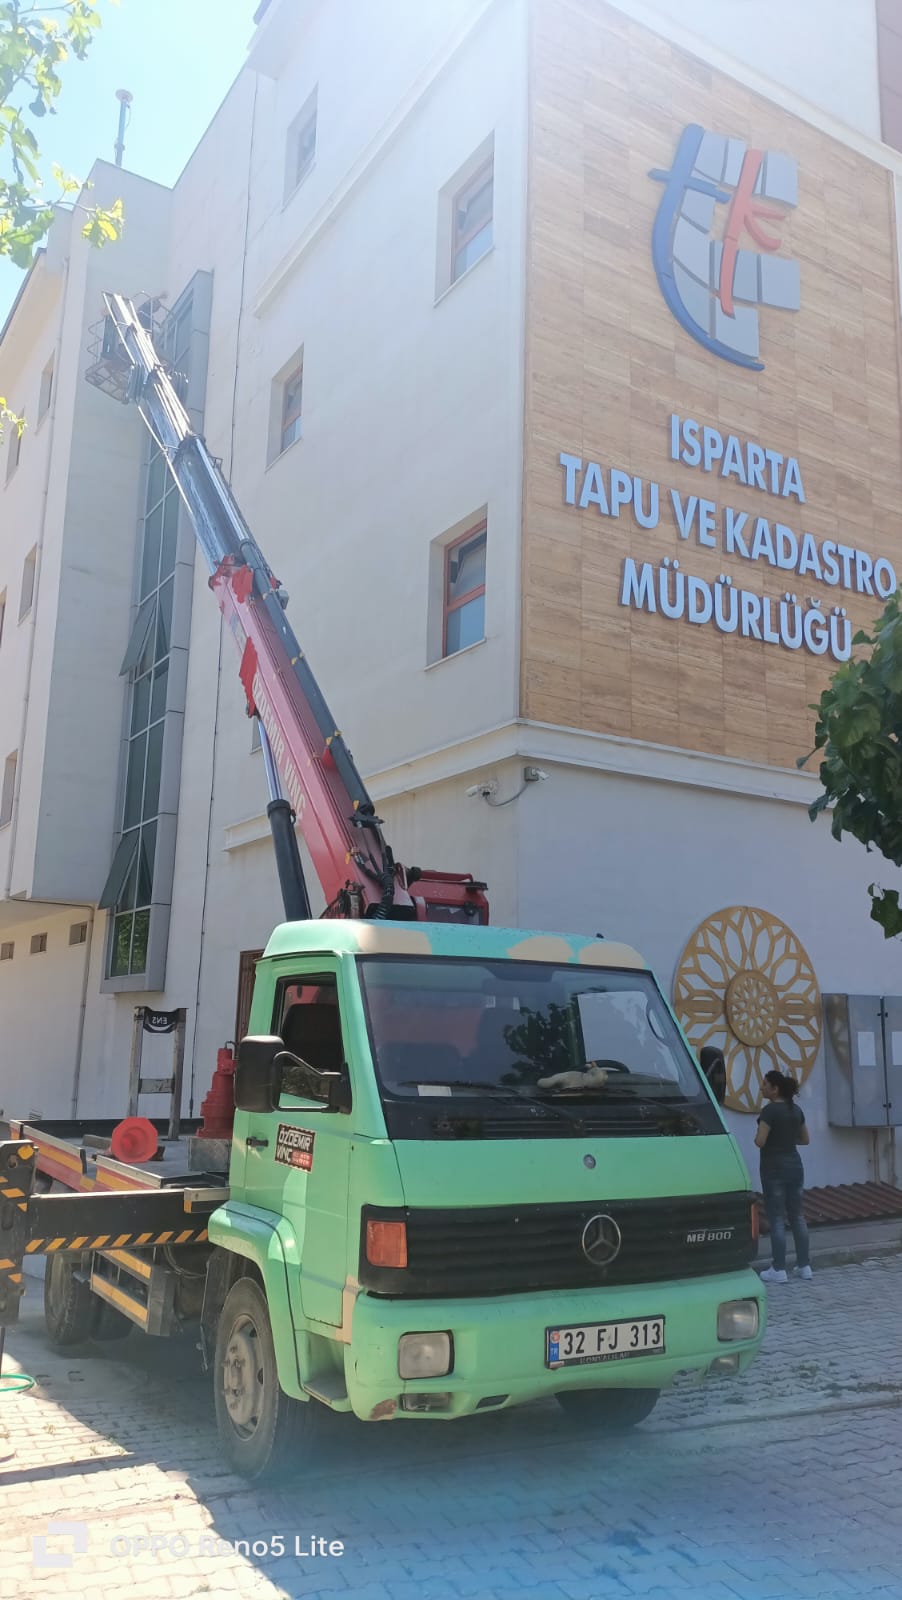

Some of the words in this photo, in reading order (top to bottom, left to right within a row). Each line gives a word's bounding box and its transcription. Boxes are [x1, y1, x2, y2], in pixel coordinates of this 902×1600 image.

[670, 413, 807, 504] ISPARTA
[559, 452, 660, 530] TAPU
[669, 488, 718, 549] VE
[725, 506, 898, 601] KADASTRO
[619, 555, 853, 663] MÜDÜRLÜĞÜ
[686, 1232, 705, 1243] MB
[707, 1231, 732, 1241] 800
[563, 1331, 586, 1356] 32
[597, 1326, 619, 1352] FJ
[629, 1322, 661, 1348] 313
